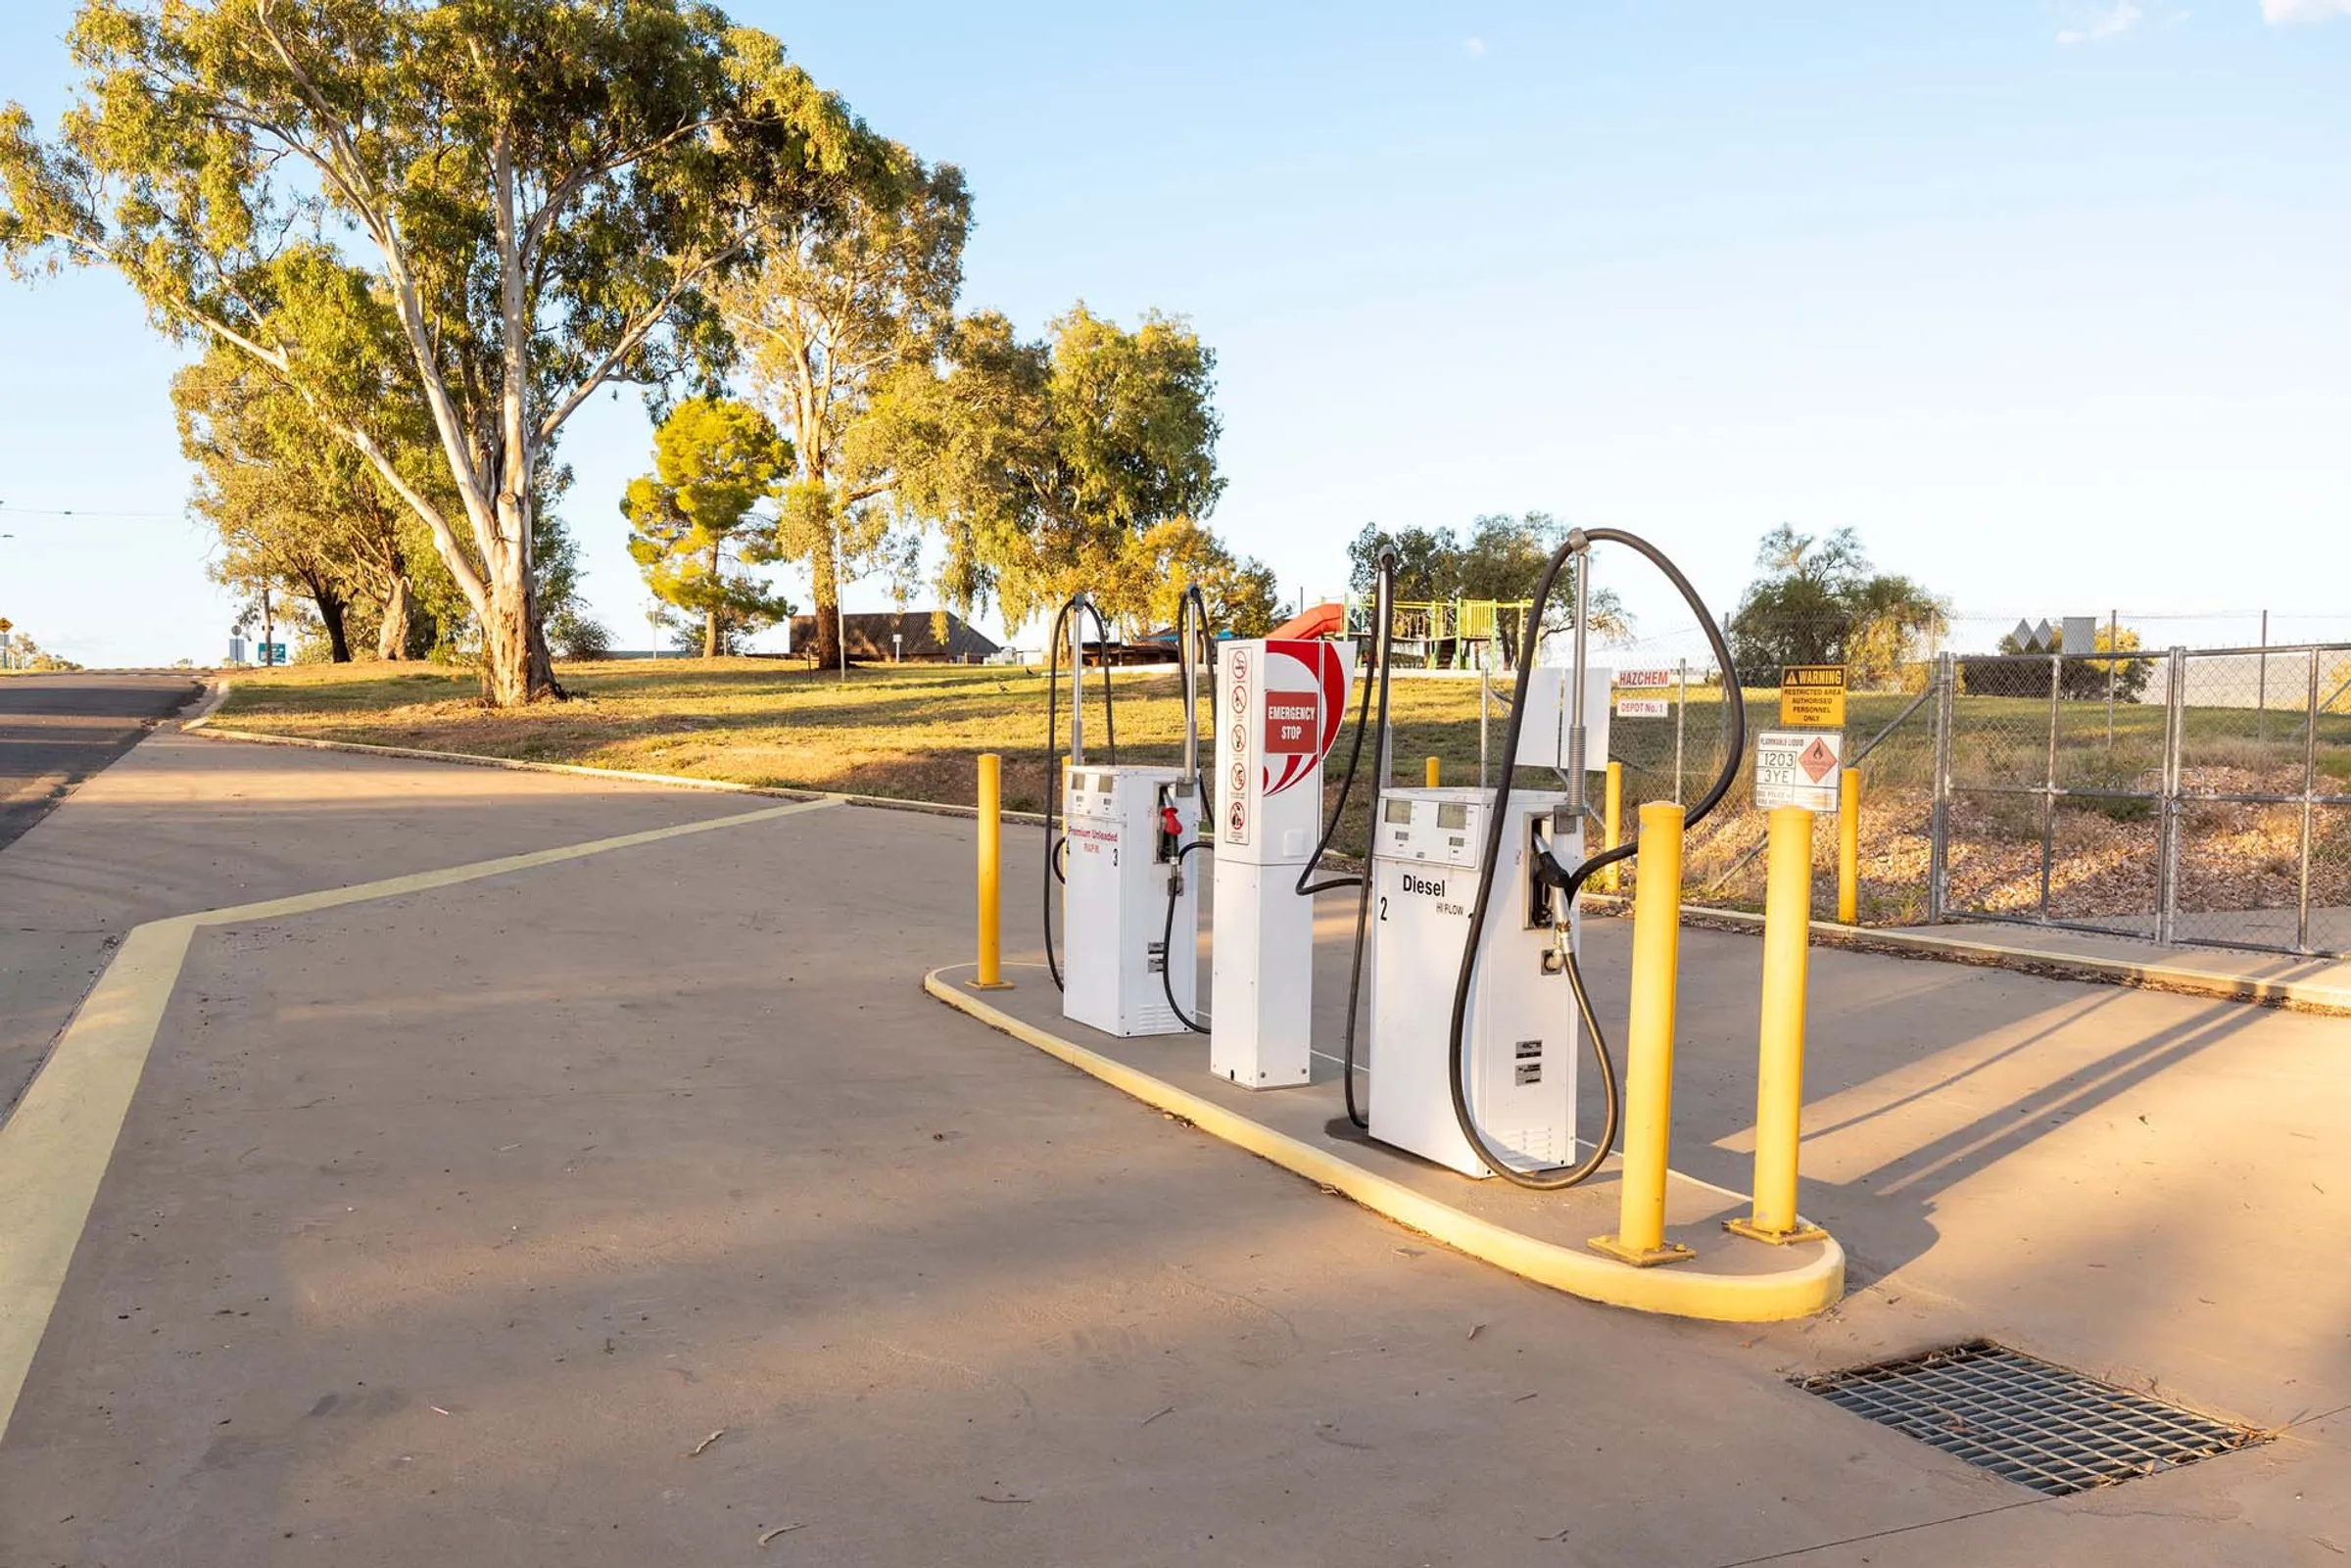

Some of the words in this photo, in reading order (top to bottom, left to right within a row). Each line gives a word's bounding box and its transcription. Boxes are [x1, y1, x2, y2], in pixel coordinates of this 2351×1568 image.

[1619, 671, 1668, 686] HAZCHEM
[1799, 670, 1842, 685] WARNING
[1268, 706, 1316, 720] EMERGENCY
[1621, 702, 1644, 713] DEPOT
[1659, 703, 1663, 713] 1
[1281, 726, 1302, 739] STOP
[1764, 752, 1794, 767] 1203
[1764, 769, 1789, 784] 3YE
[1090, 830, 1118, 841] Unleaded
[1113, 848, 1119, 867] 3
[1403, 874, 1446, 897] Diesel
[1380, 896, 1388, 921] 2
[1436, 902, 1443, 912] HI
[1444, 904, 1463, 916] FLOW
